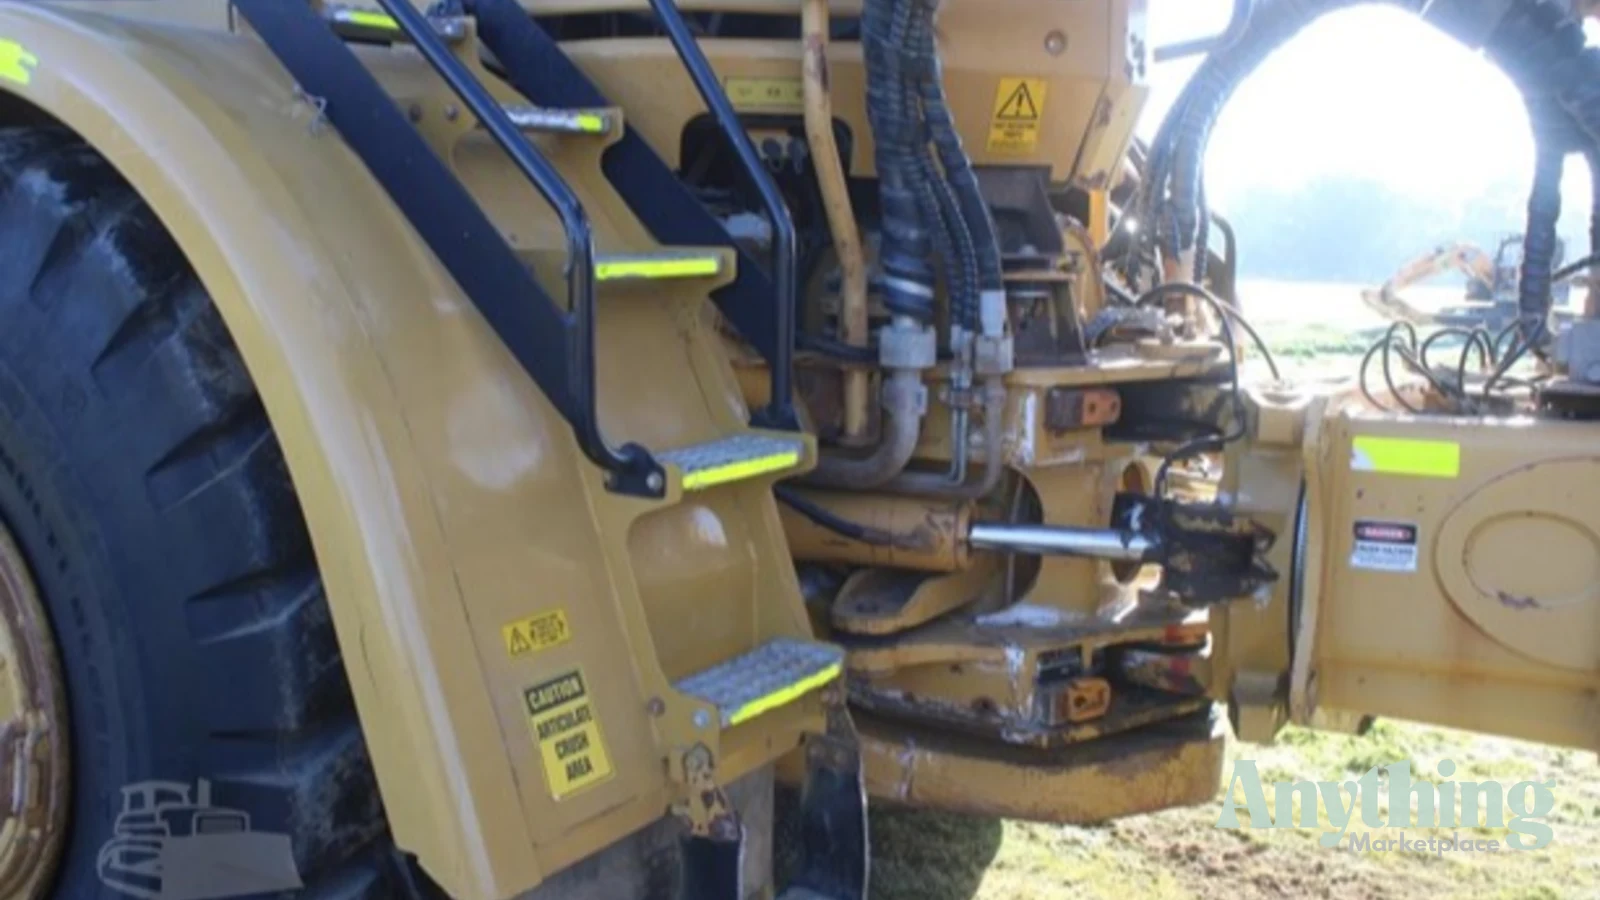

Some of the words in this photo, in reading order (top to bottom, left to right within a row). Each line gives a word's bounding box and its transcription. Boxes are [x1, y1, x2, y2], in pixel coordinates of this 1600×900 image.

[528, 676, 581, 711] CAUTION
[536, 704, 592, 741] ARTICULATE
[554, 730, 590, 761] CRUSH
[565, 755, 592, 782] AREA
